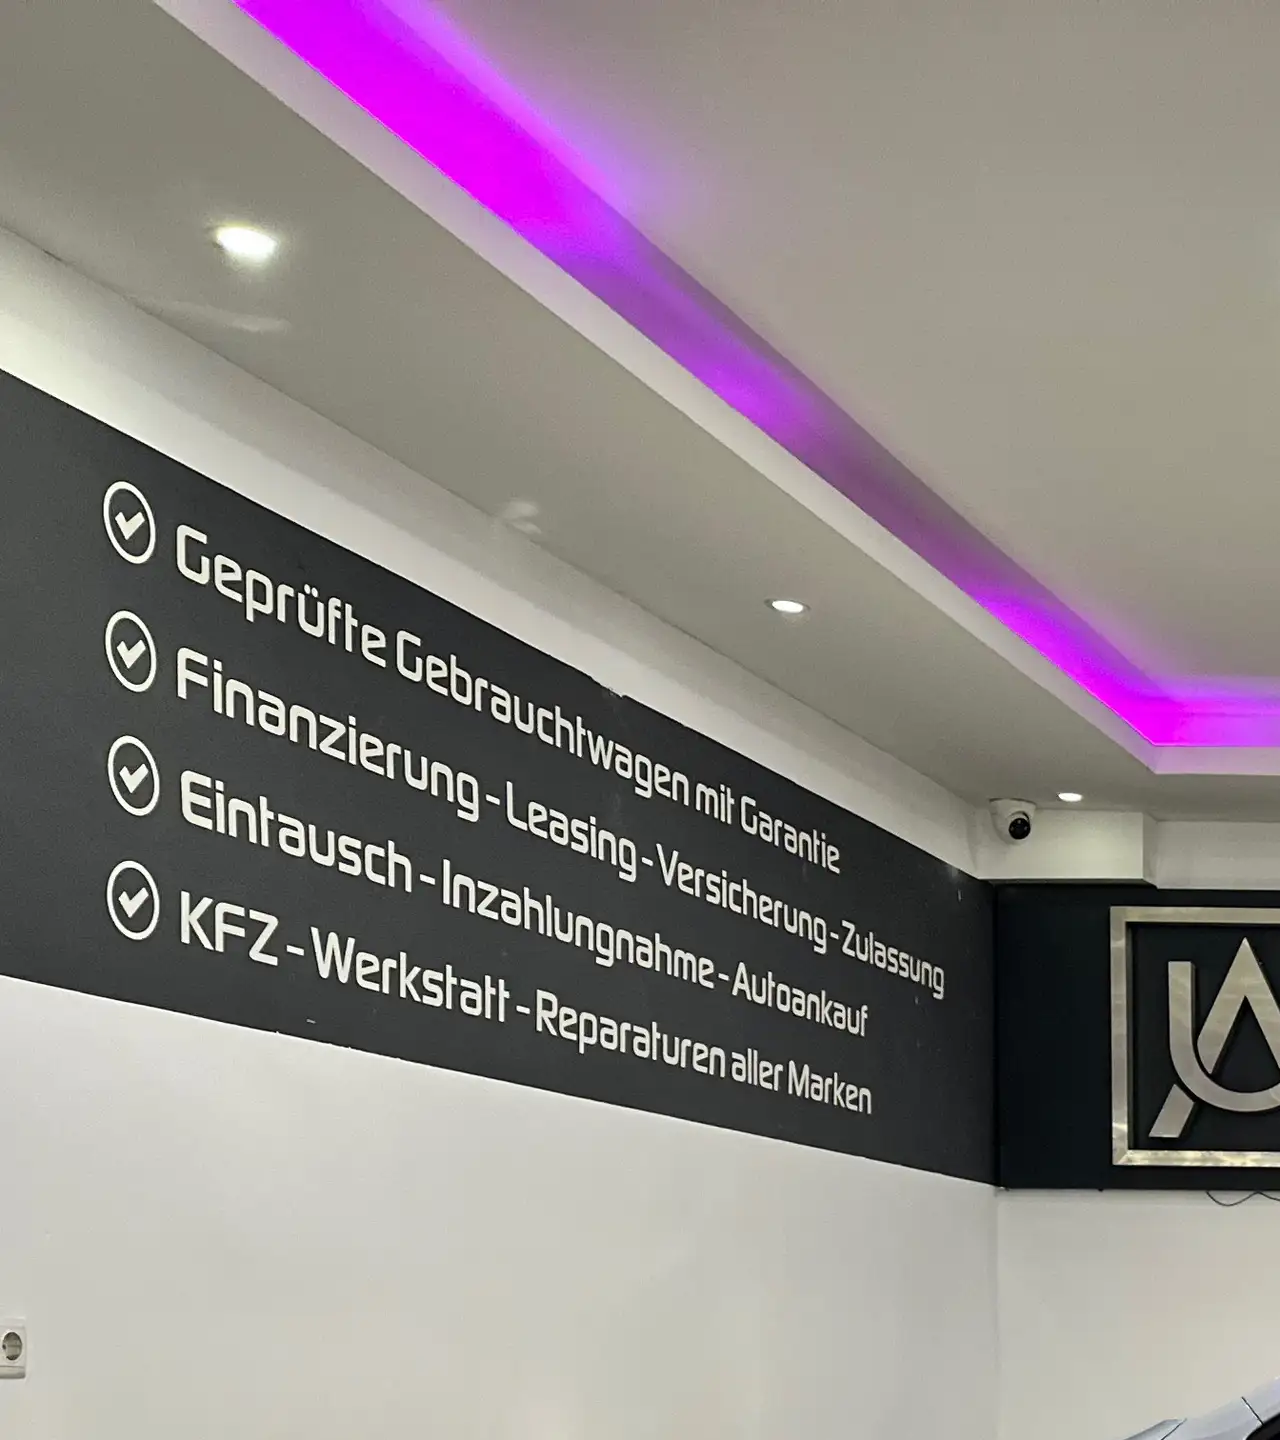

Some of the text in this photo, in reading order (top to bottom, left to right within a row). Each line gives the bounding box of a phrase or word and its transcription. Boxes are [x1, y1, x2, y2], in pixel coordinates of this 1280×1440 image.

[177, 525, 840, 874] Geprüfte Gebrauchtwagen mit Garantie
[732, 1048, 784, 1091] aller
[788, 1061, 872, 1114] Marken
